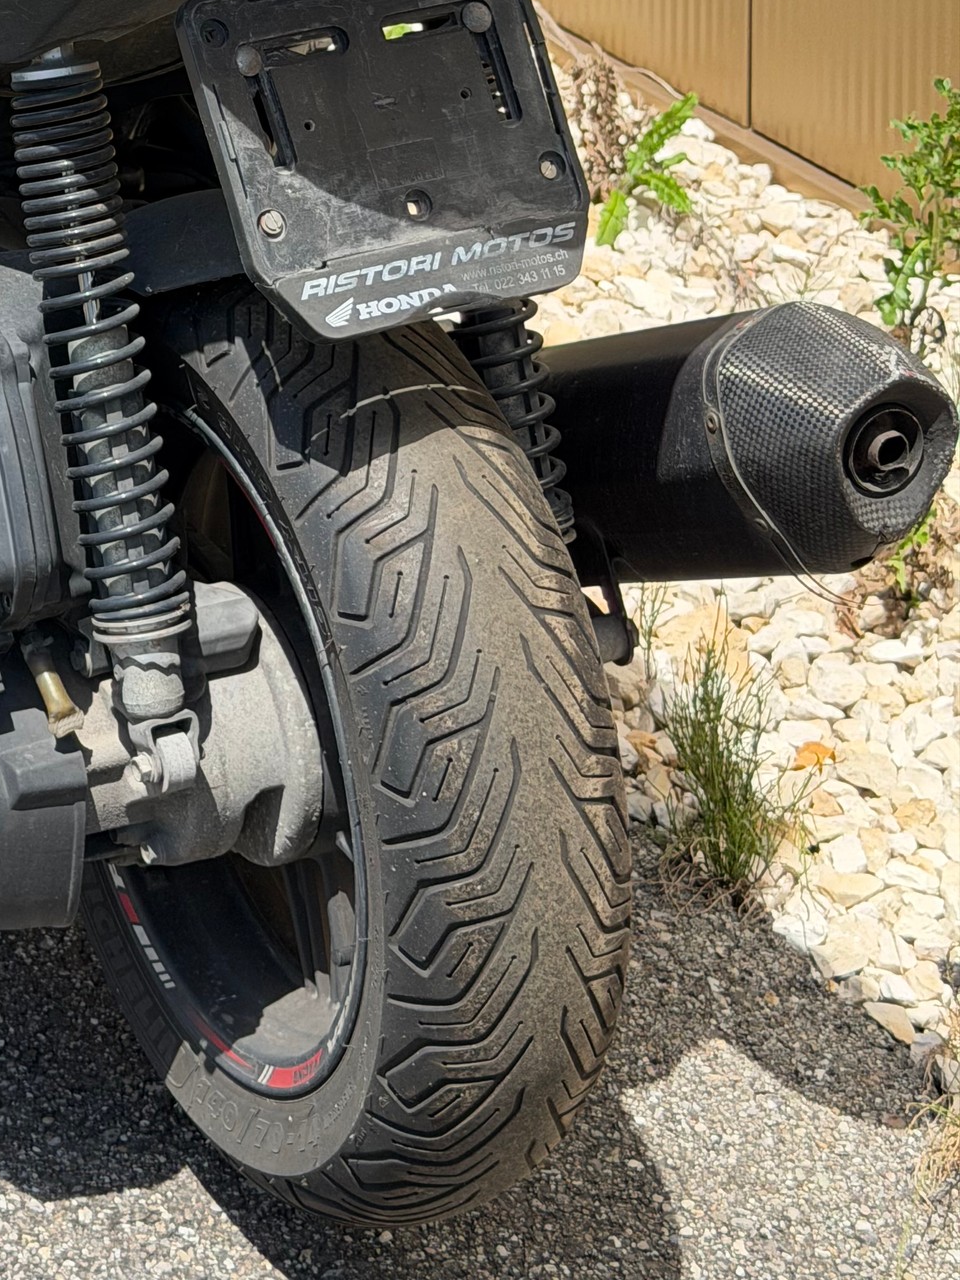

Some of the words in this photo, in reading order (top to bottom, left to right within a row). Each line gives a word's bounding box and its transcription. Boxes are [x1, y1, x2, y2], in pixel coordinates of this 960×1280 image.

[301, 251, 442, 301] RISTORI
[451, 221, 576, 266] MOTOS
[494, 276, 515, 290] 022
[517, 270, 538, 285] 343
[541, 267, 552, 280] 11
[553, 264, 567, 277] 15
